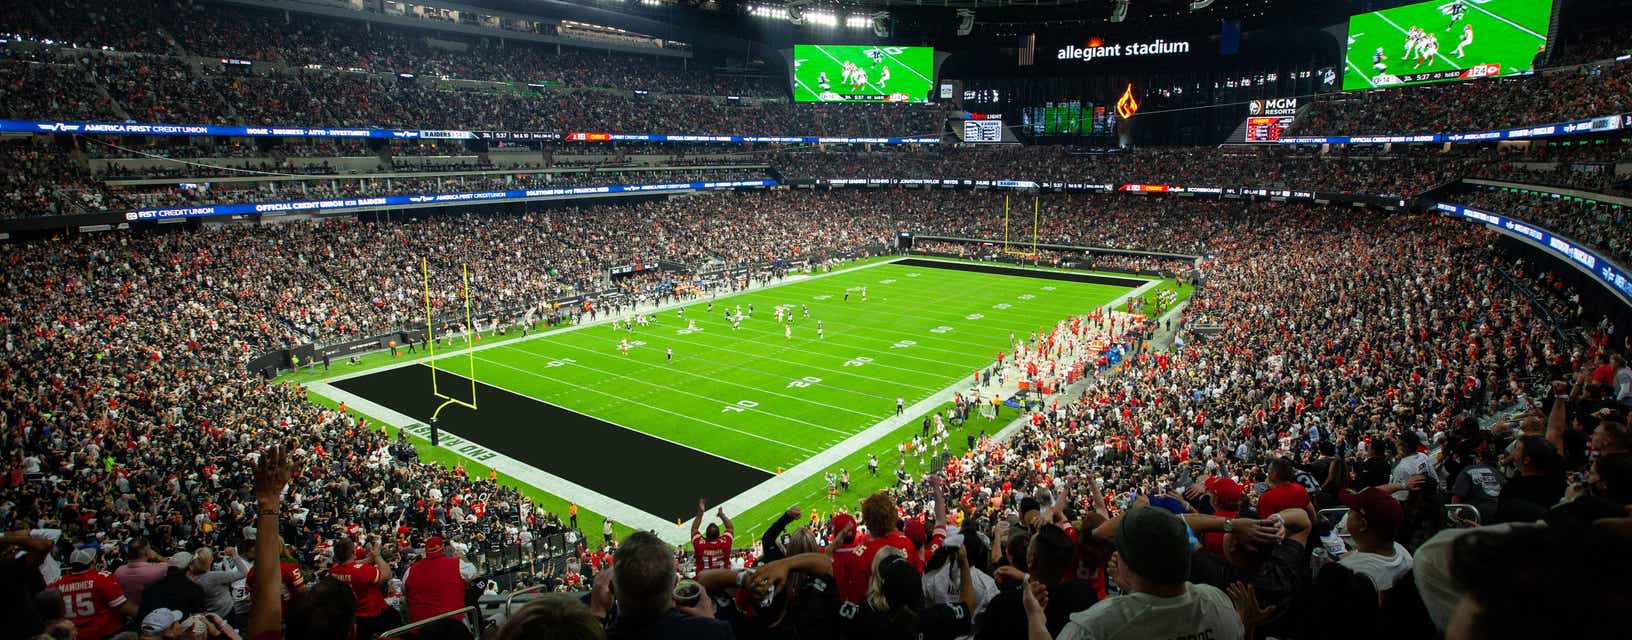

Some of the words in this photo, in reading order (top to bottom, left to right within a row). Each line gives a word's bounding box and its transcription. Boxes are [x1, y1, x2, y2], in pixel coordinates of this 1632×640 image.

[1057, 44, 1120, 61] allegiant
[1125, 39, 1189, 56] stadium
[1416, 73, 1430, 81] 5:37
[1474, 66, 1486, 75] 24
[1265, 98, 1296, 109] MGM
[84, 124, 125, 132] AMERICA
[329, 129, 370, 137] INVESTMENTS
[255, 203, 292, 211] OFFICIAL
[319, 200, 344, 208] UNION
[358, 198, 387, 206] RAIDERS
[158, 208, 187, 216] CREDIT
[187, 207, 214, 215] UNION
[545, 357, 576, 368] 10
[787, 376, 822, 388] 20
[721, 400, 759, 413] 10
[456, 444, 497, 461] END
[702, 555, 724, 568] 15
[59, 580, 94, 593] MAHOMES
[62, 592, 95, 618] 15
